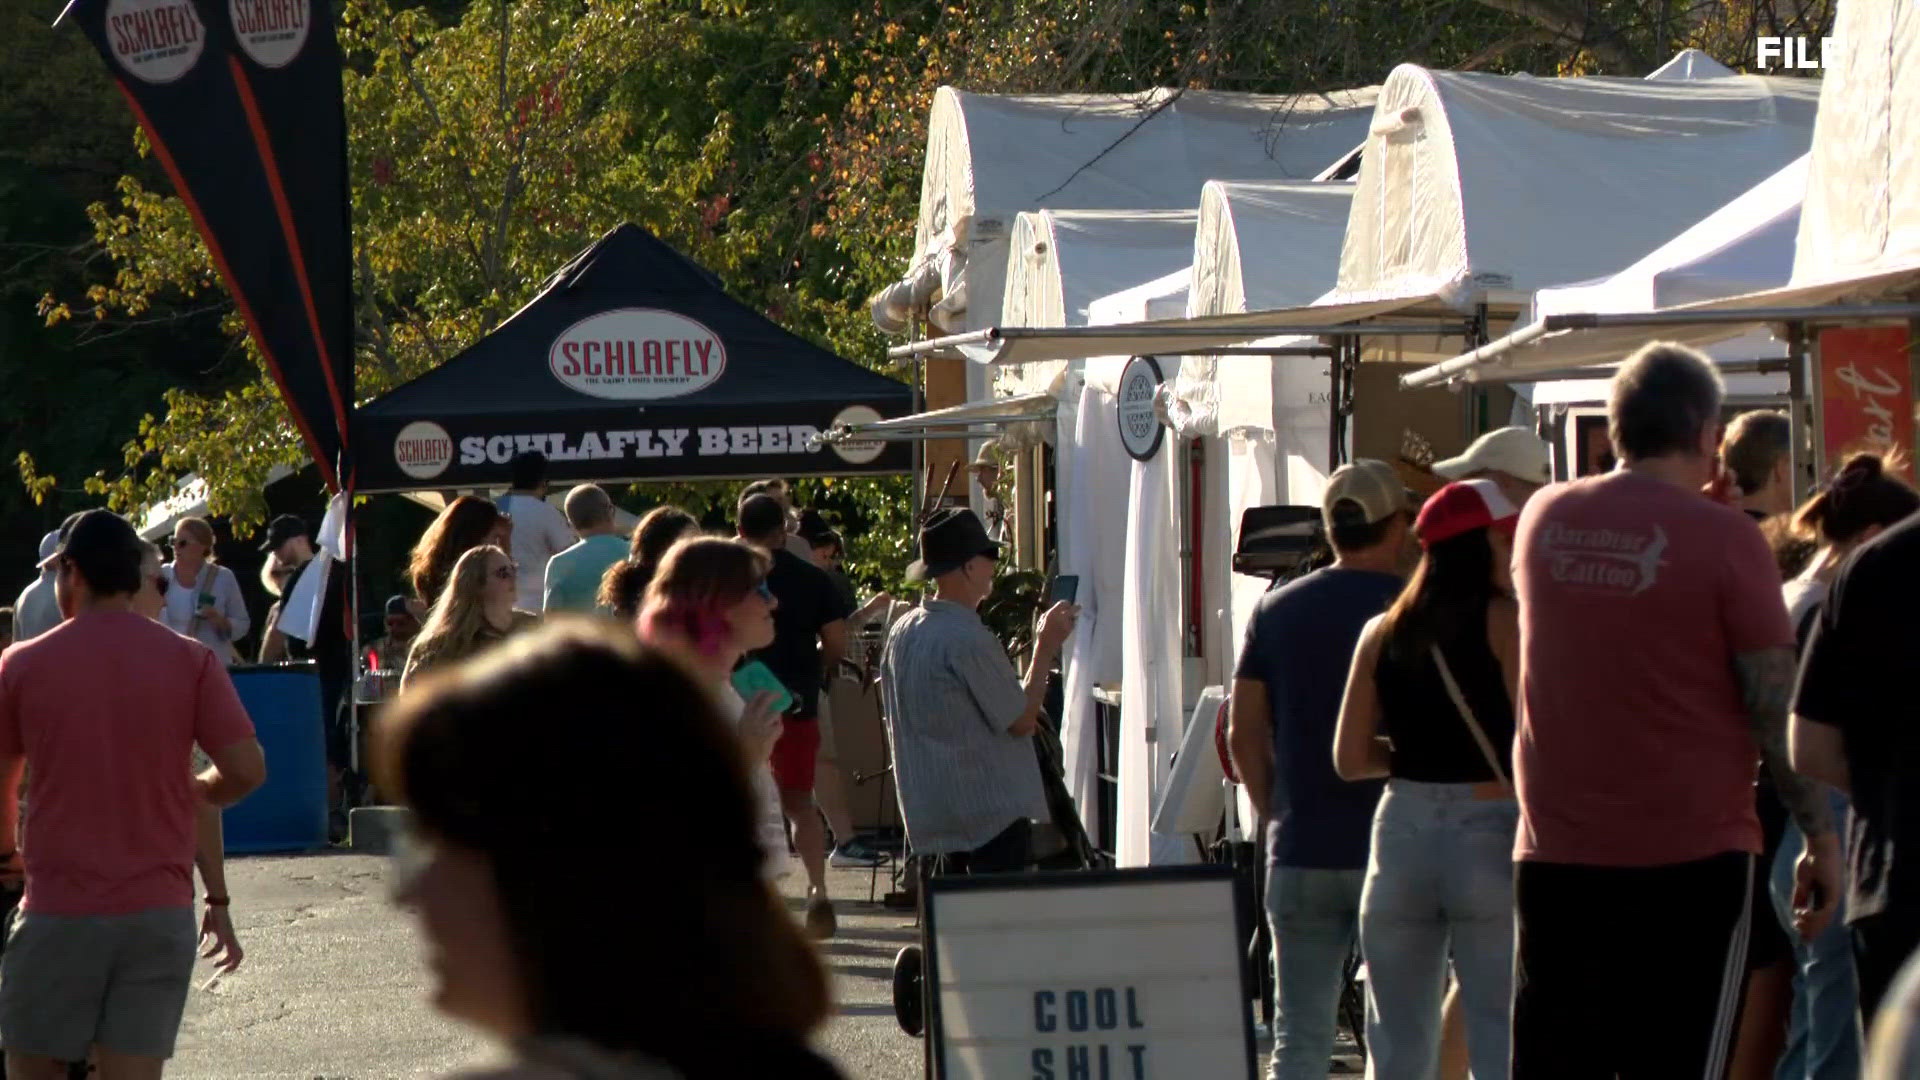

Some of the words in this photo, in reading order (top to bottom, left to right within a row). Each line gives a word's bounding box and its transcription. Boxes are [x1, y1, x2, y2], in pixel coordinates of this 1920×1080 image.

[111, 4, 198, 55] SCHLAFLY
[562, 340, 713, 376] SCHLAFLY
[398, 439, 448, 462] SCHLAFLY
[460, 429, 690, 465] SCHLAFLY
[697, 425, 822, 456] BEER
[1541, 521, 1647, 551] Paradise
[1551, 556, 1636, 588] Tattoo
[1033, 986, 1144, 1033] COOL
[1031, 1044, 1146, 1080] SHIT
